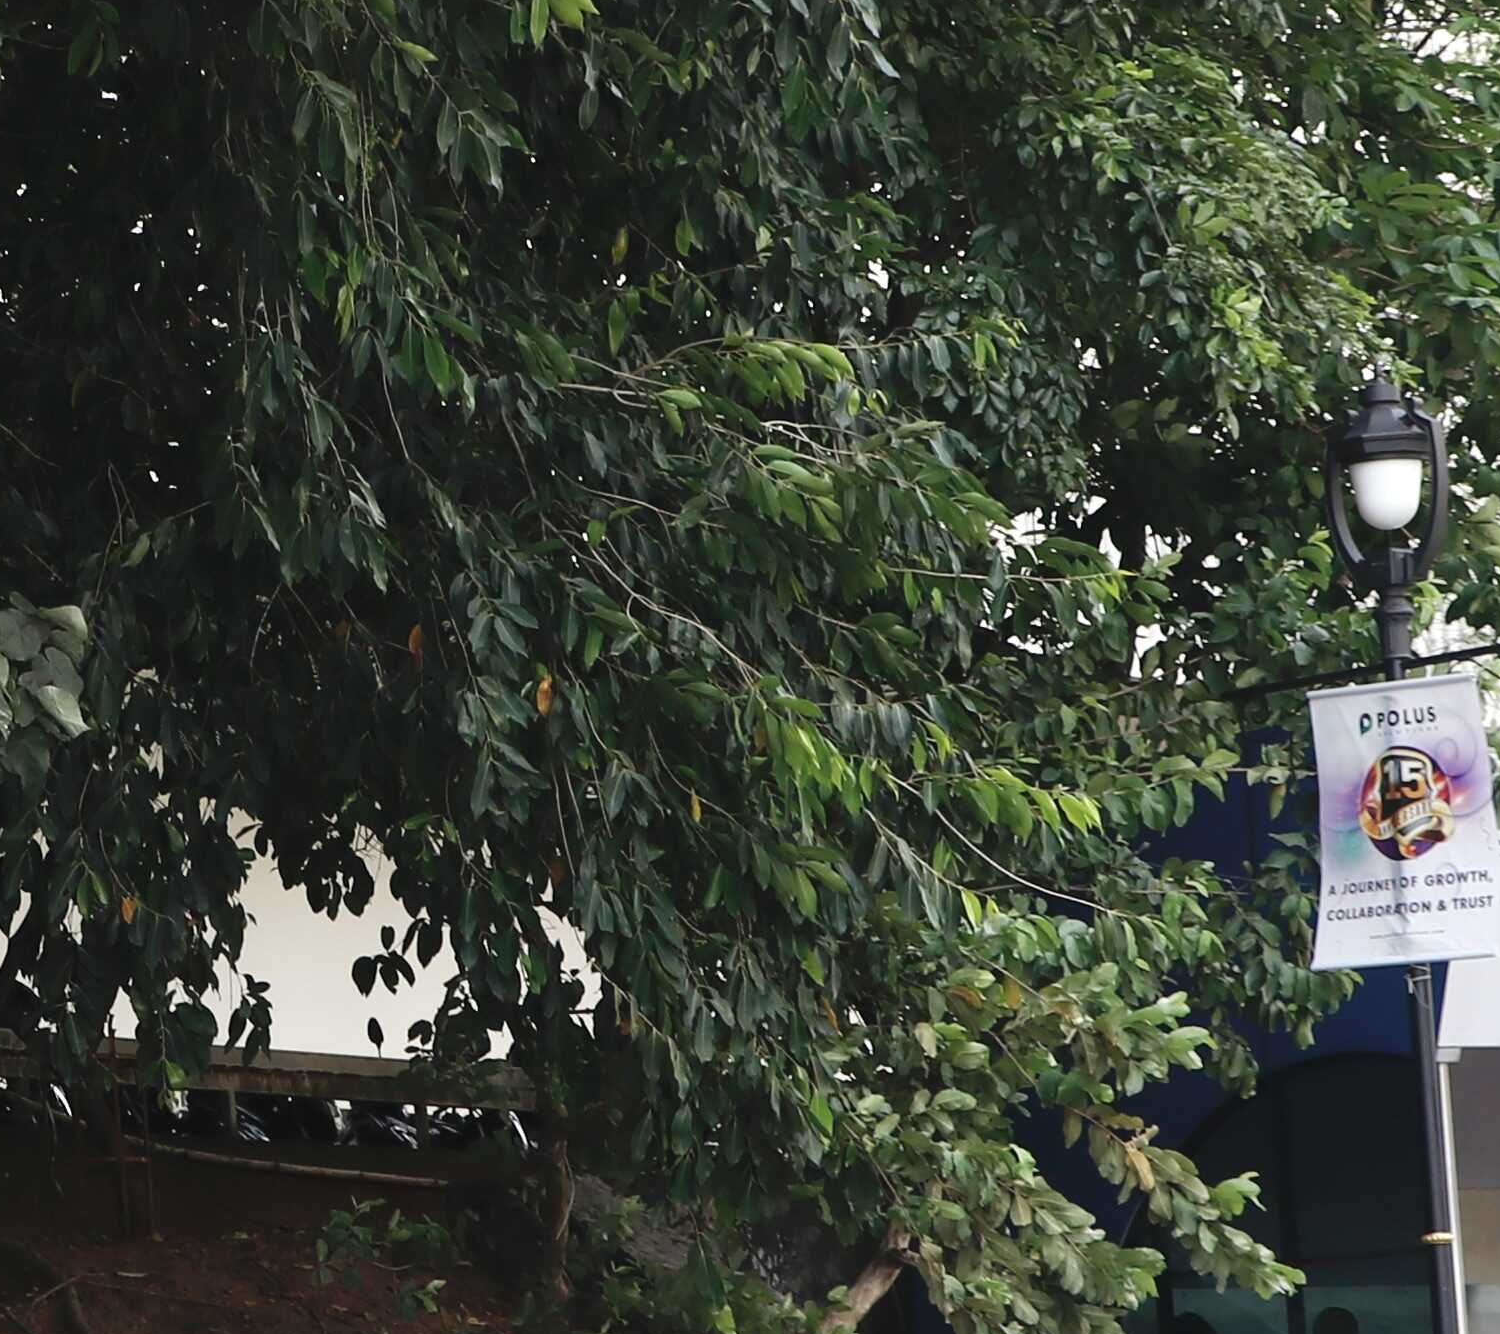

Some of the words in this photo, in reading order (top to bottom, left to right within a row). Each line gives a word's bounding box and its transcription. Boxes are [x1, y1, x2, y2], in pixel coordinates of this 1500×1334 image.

[1377, 706, 1437, 728] POLUS
[1384, 759, 1427, 799] 15
[1328, 884, 1337, 897] A
[1341, 878, 1397, 895] JOURNEY
[1400, 875, 1419, 889] OF
[1438, 900, 1448, 912] &
[1452, 895, 1494, 910] TRUST
